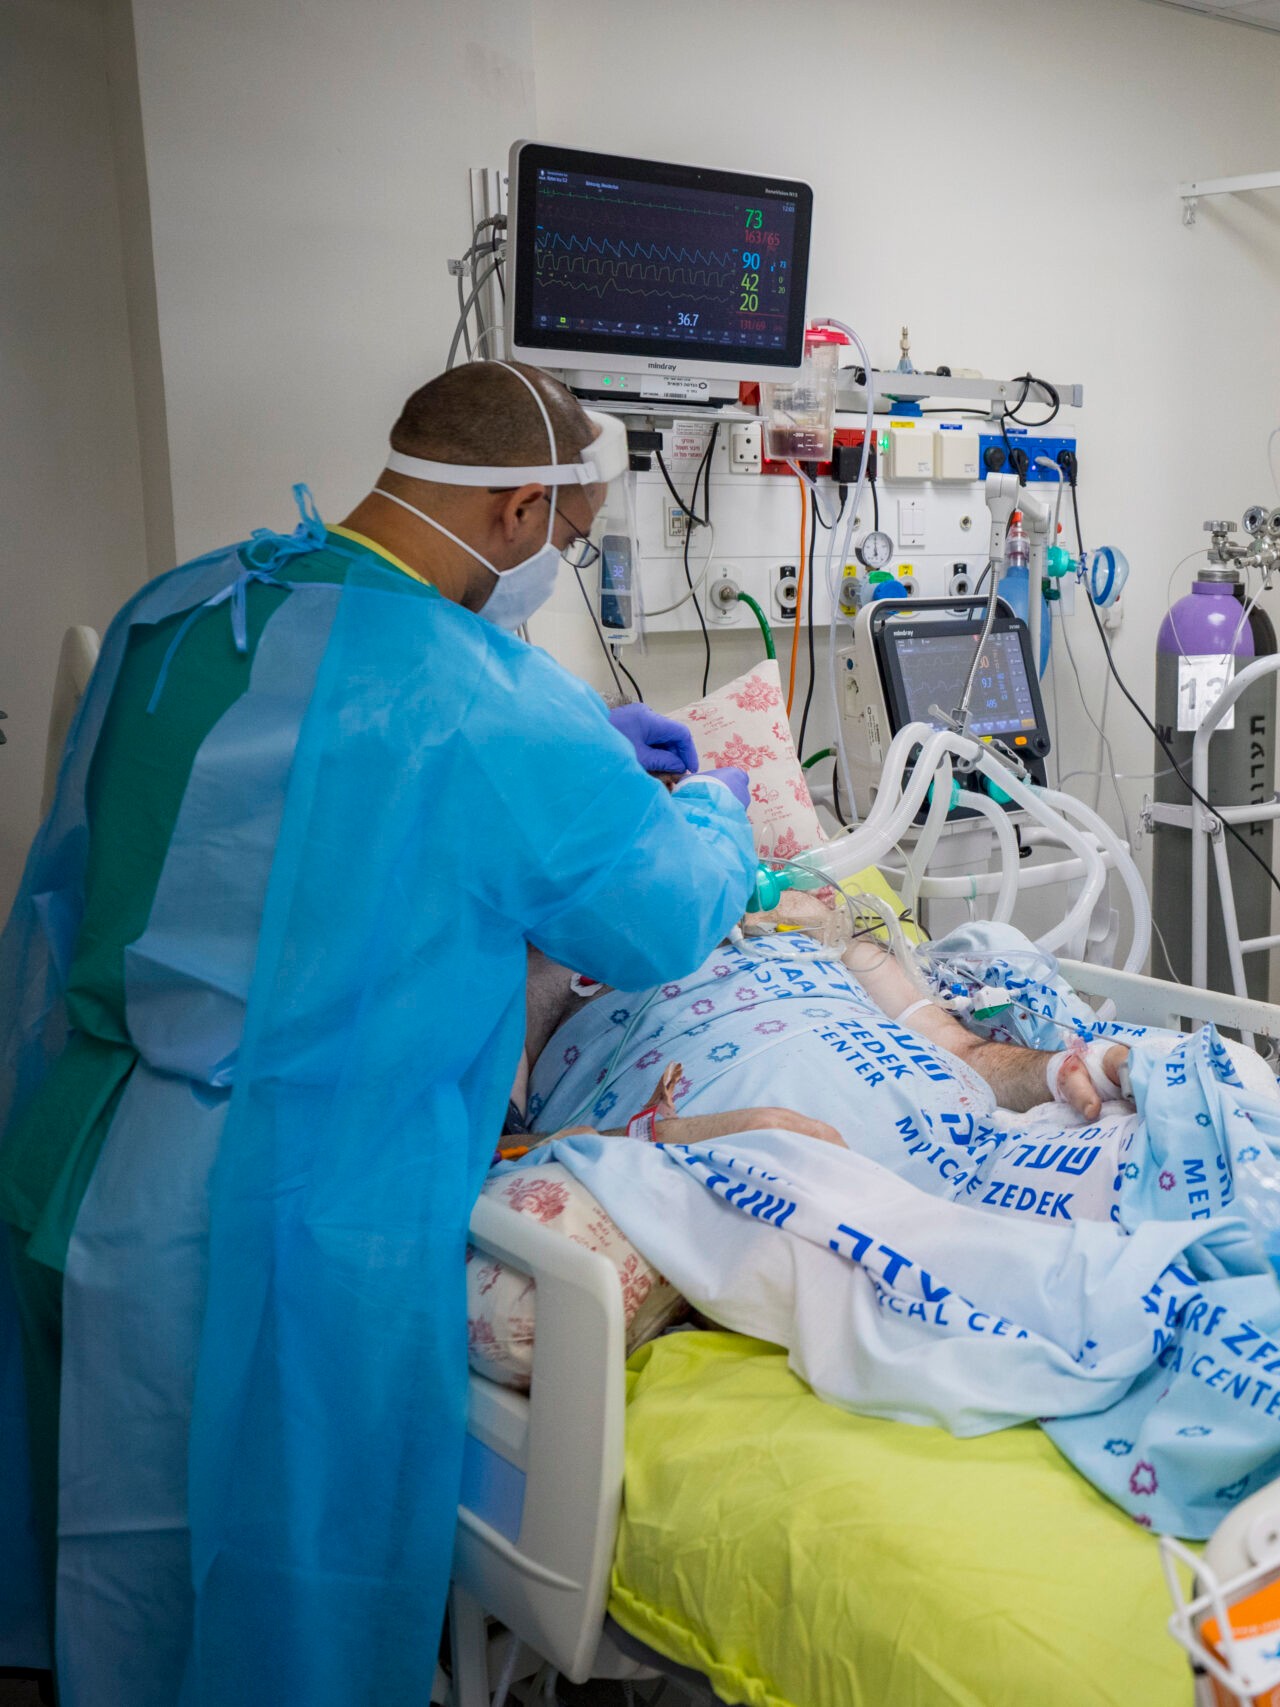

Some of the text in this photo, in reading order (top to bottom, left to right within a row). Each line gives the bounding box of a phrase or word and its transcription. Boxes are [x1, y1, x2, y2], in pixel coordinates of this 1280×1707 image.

[744, 208, 763, 229] 73
[742, 252, 761, 270] 90
[741, 273, 759, 292] 42
[739, 293, 759, 312] 20
[677, 312, 700, 327] 36.7
[648, 361, 677, 372] mindray
[814, 1025, 885, 1088] ENTER
[837, 1020, 914, 1080] ZEDEK
[982, 1181, 1074, 1221] ZEDEK
